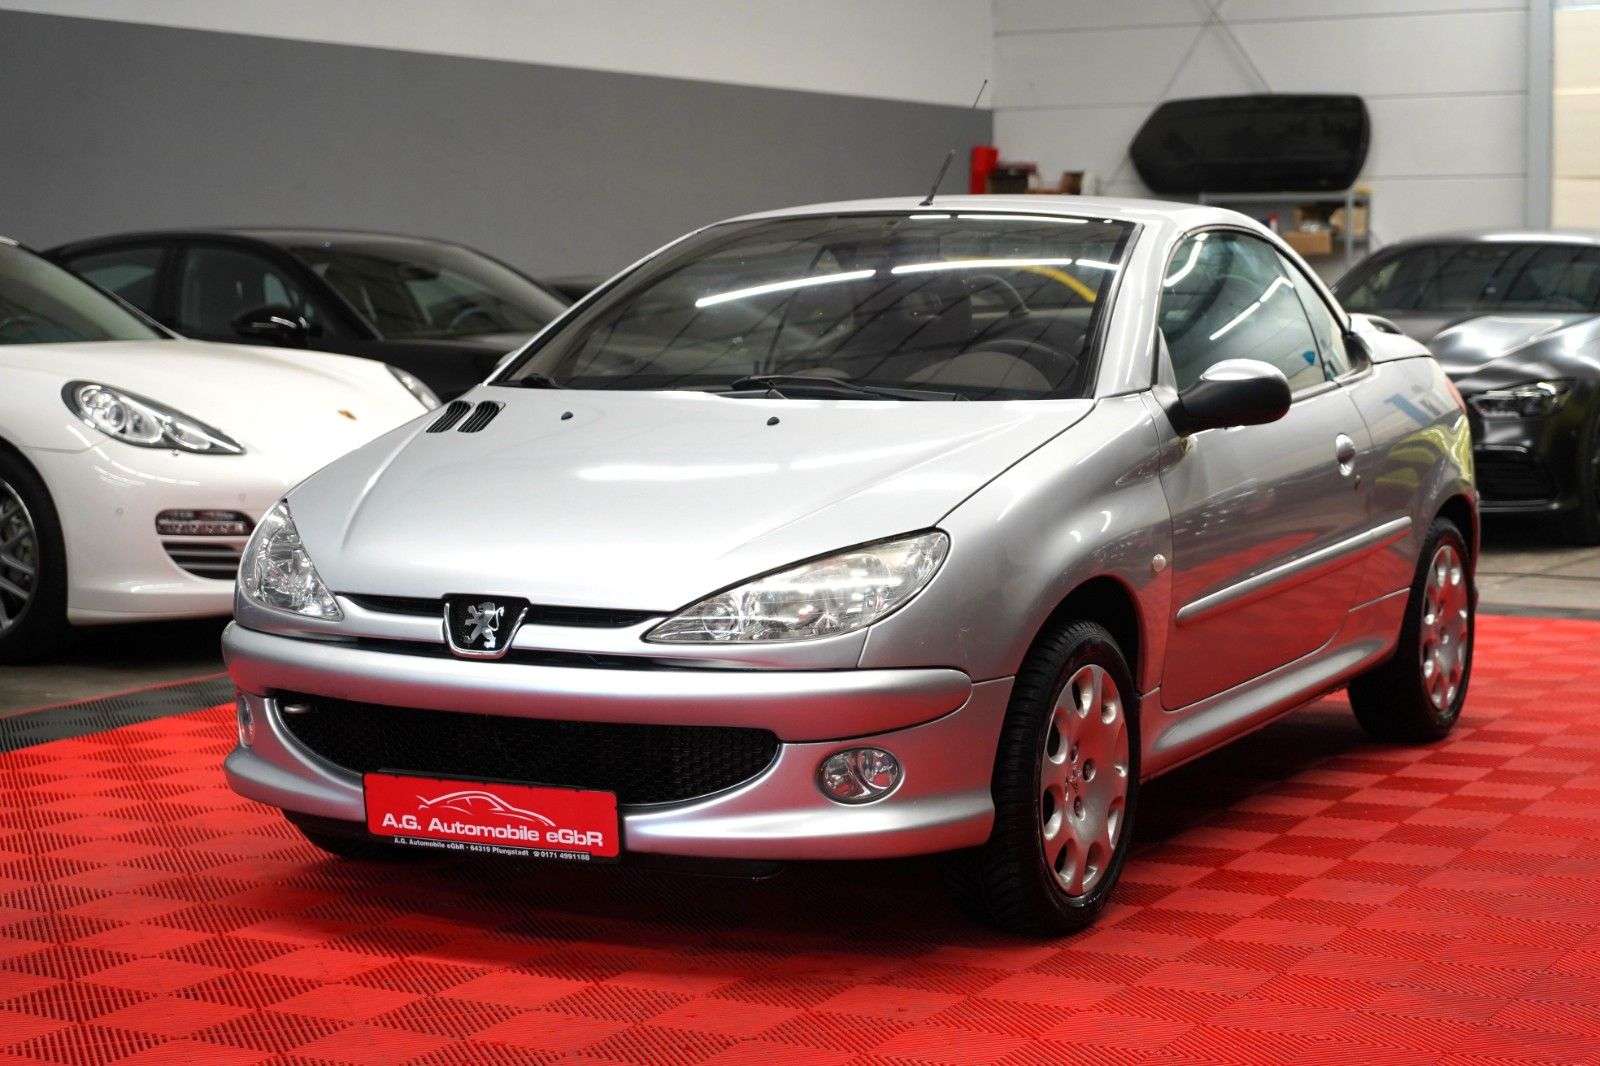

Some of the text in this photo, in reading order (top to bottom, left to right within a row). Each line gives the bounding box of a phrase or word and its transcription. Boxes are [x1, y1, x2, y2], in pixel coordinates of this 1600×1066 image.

[382, 812, 604, 847] A.G. Automobile eGbR
[394, 837, 408, 845] A.G.
[409, 838, 445, 848] Automobile
[470, 845, 491, 854] 64319
[492, 847, 530, 857] Pfungstadt
